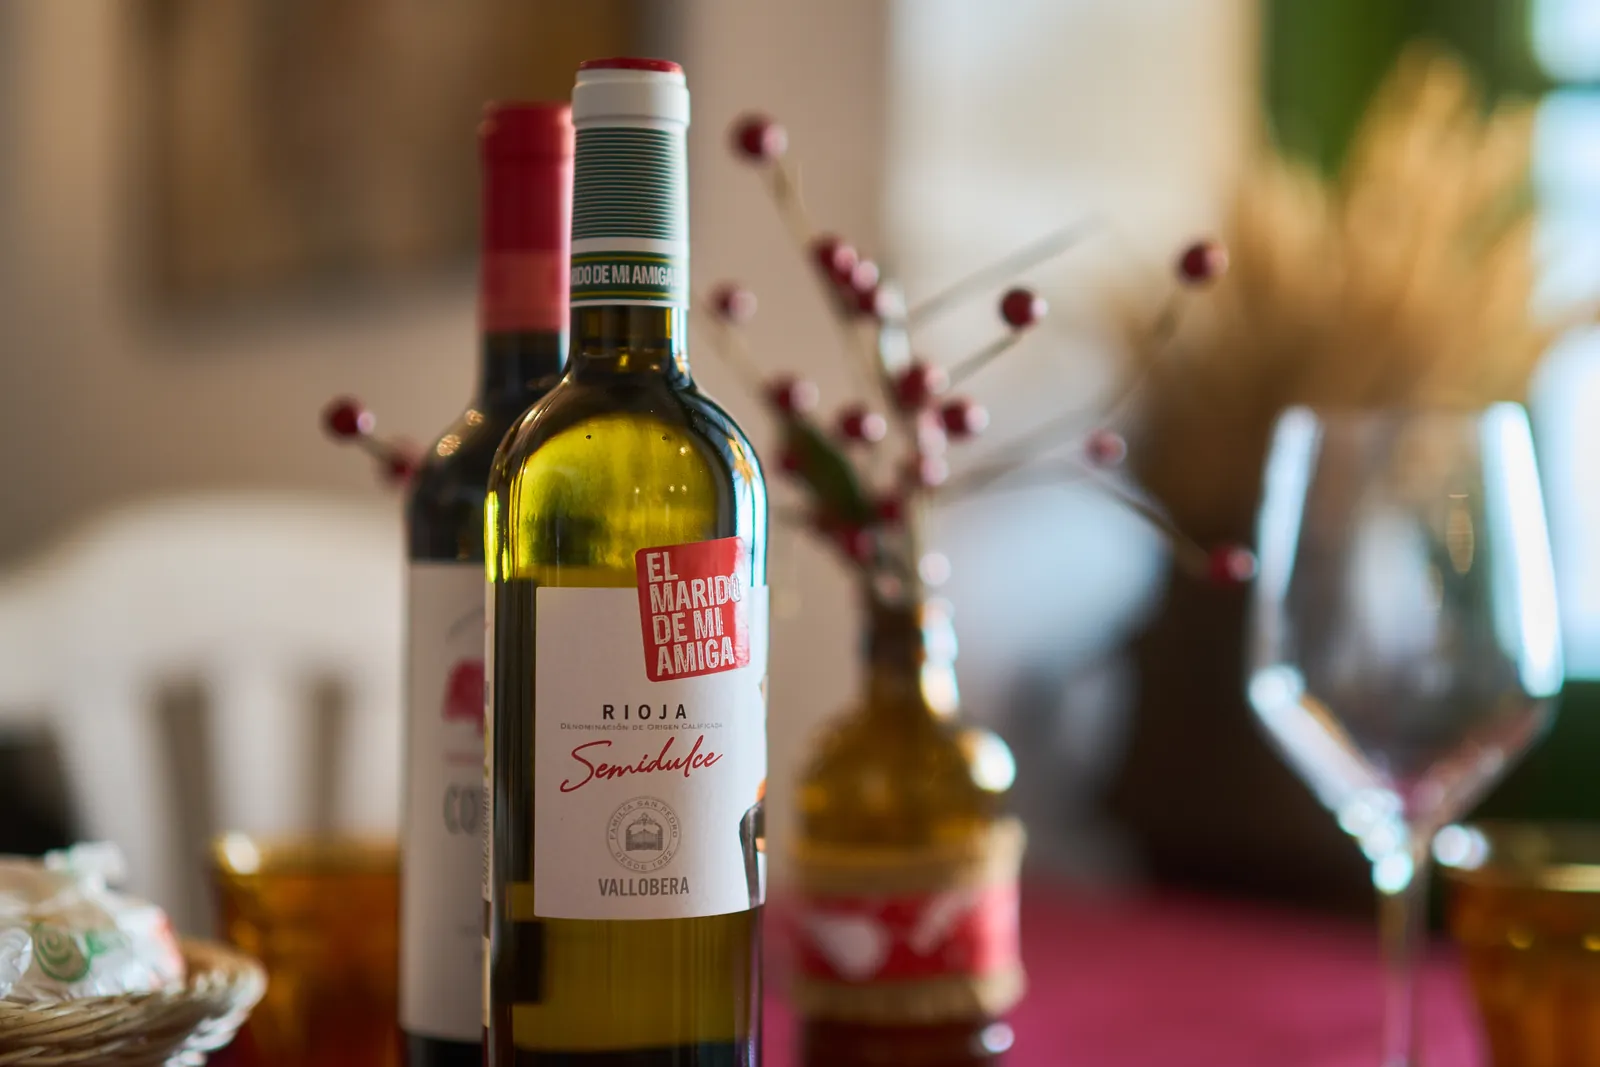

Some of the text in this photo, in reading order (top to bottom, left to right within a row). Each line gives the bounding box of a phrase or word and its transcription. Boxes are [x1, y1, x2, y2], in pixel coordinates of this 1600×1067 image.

[593, 265, 610, 284] DE
[612, 264, 630, 284] MI
[632, 265, 673, 287] AMIGA
[646, 551, 679, 583] EL
[649, 572, 741, 614] MARIDO
[652, 606, 724, 645] DE MI
[657, 636, 735, 676] AMIGA
[603, 704, 687, 720] RIOJA
[559, 734, 723, 793] Semidulce
[609, 800, 678, 840] FAMILIA SAN PEDRO
[615, 851, 647, 870] DESDE
[597, 876, 690, 897] VALLOBERA
